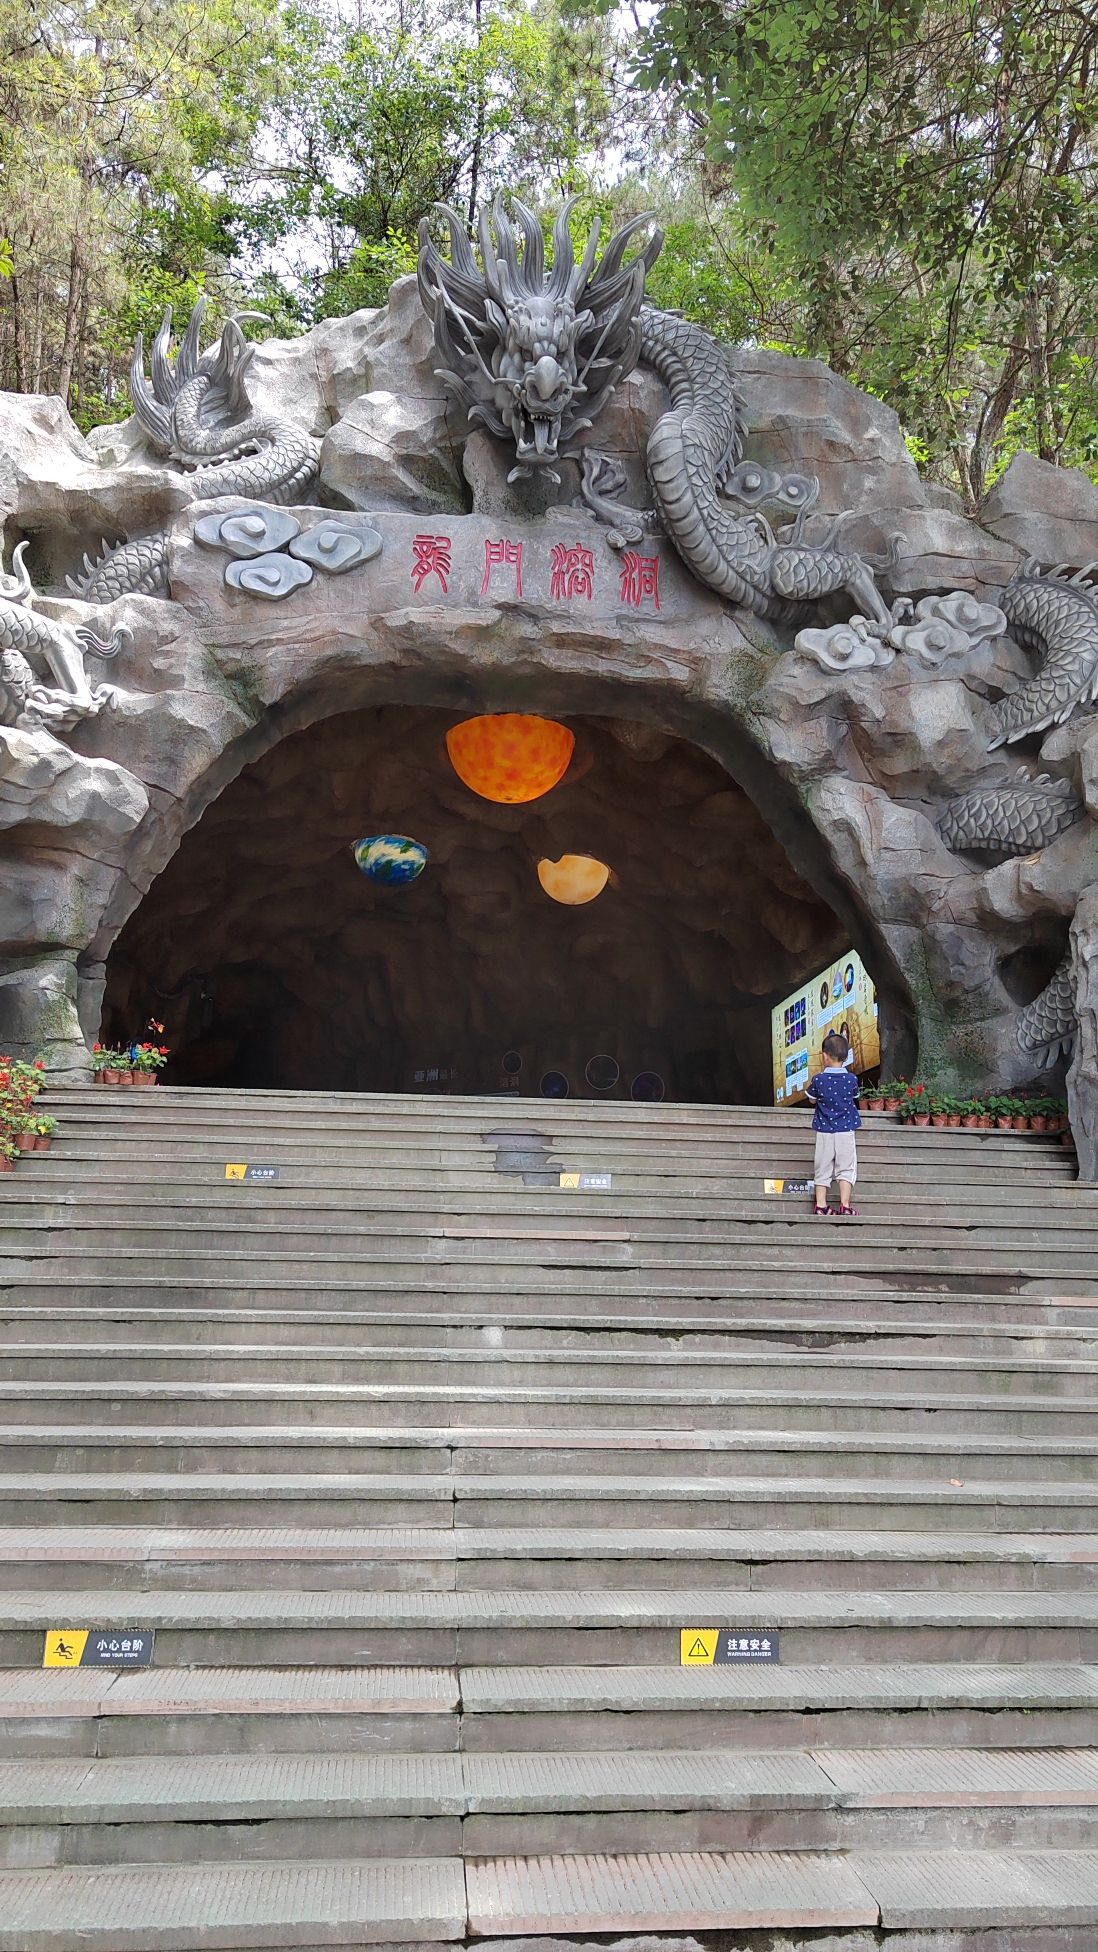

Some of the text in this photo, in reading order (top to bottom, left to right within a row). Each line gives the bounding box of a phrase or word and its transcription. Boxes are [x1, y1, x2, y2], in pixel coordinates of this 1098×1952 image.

[96, 1639, 144, 1651] 小心台阶
[727, 1638, 772, 1651] 注意安全
